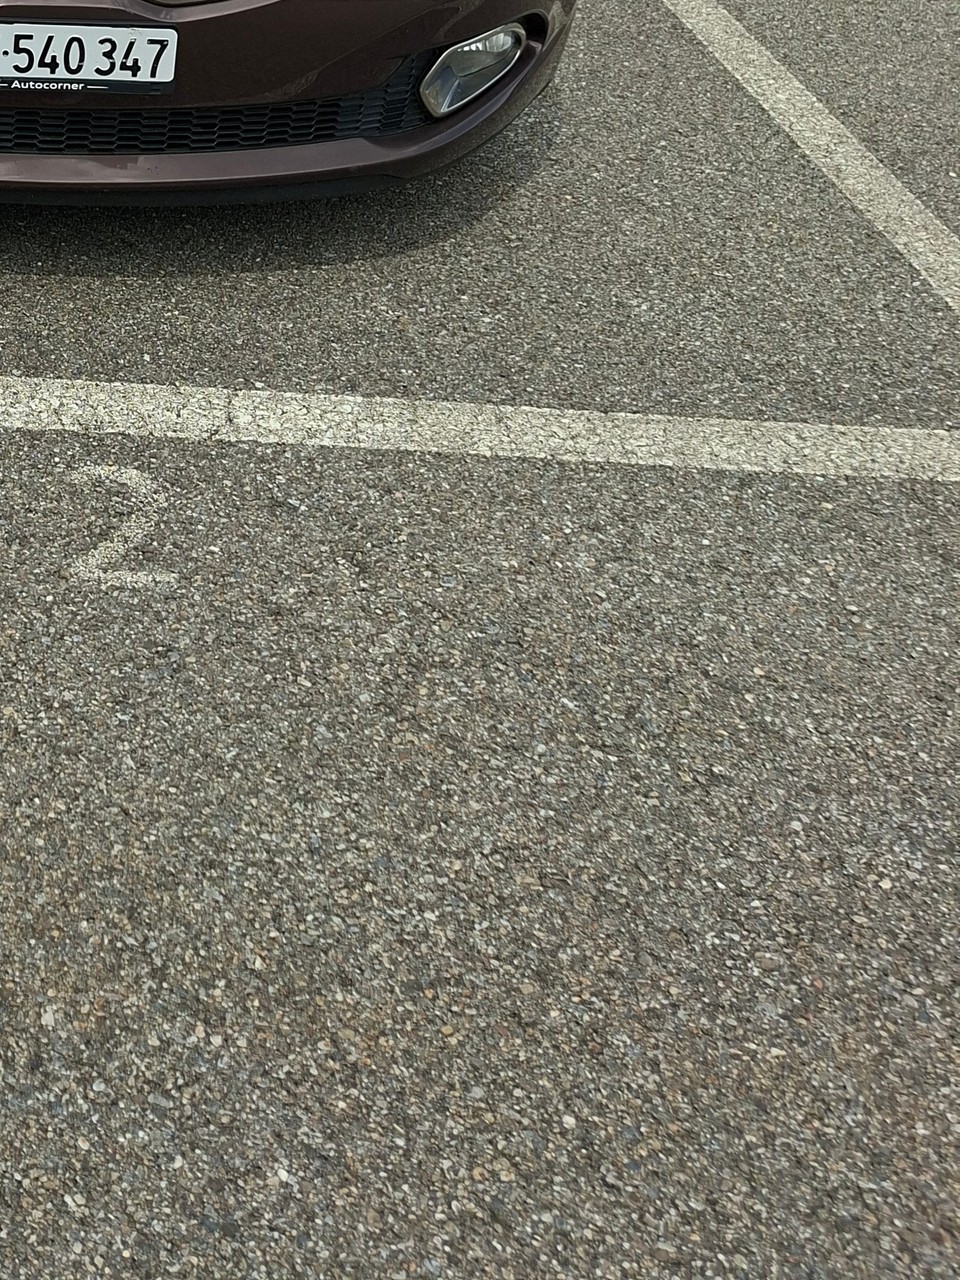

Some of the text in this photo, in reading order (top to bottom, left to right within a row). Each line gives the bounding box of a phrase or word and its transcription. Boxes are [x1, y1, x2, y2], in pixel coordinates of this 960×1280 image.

[93, 37, 170, 79] 347
[10, 79, 85, 91] Autocorner
[70, 465, 179, 586] 2
